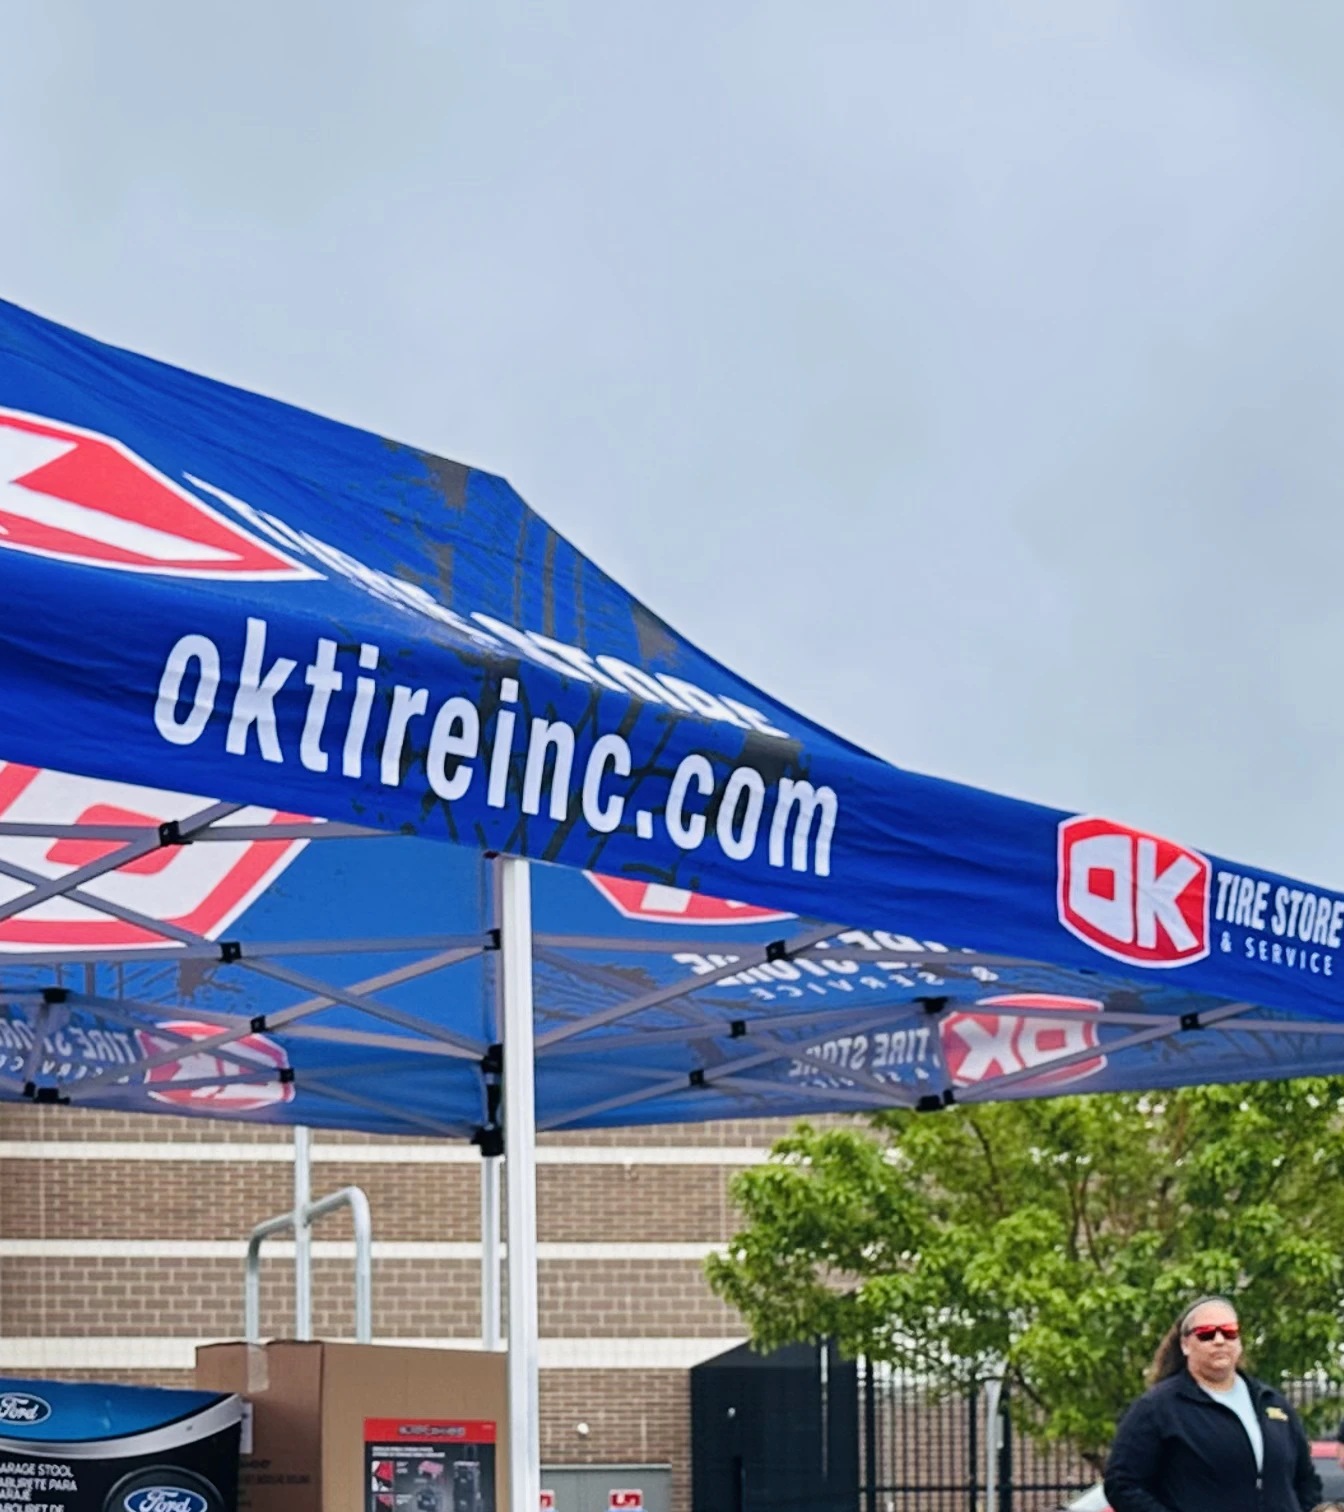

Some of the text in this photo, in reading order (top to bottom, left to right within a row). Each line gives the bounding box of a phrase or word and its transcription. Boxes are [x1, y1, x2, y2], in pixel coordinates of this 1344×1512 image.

[153, 616, 840, 877] oktireinc.com
[1068, 833, 1203, 953] OK
[1214, 871, 1271, 931] TIRE
[1219, 930, 1334, 977] & SERVICE
[37, 1463, 75, 1478] STOOL
